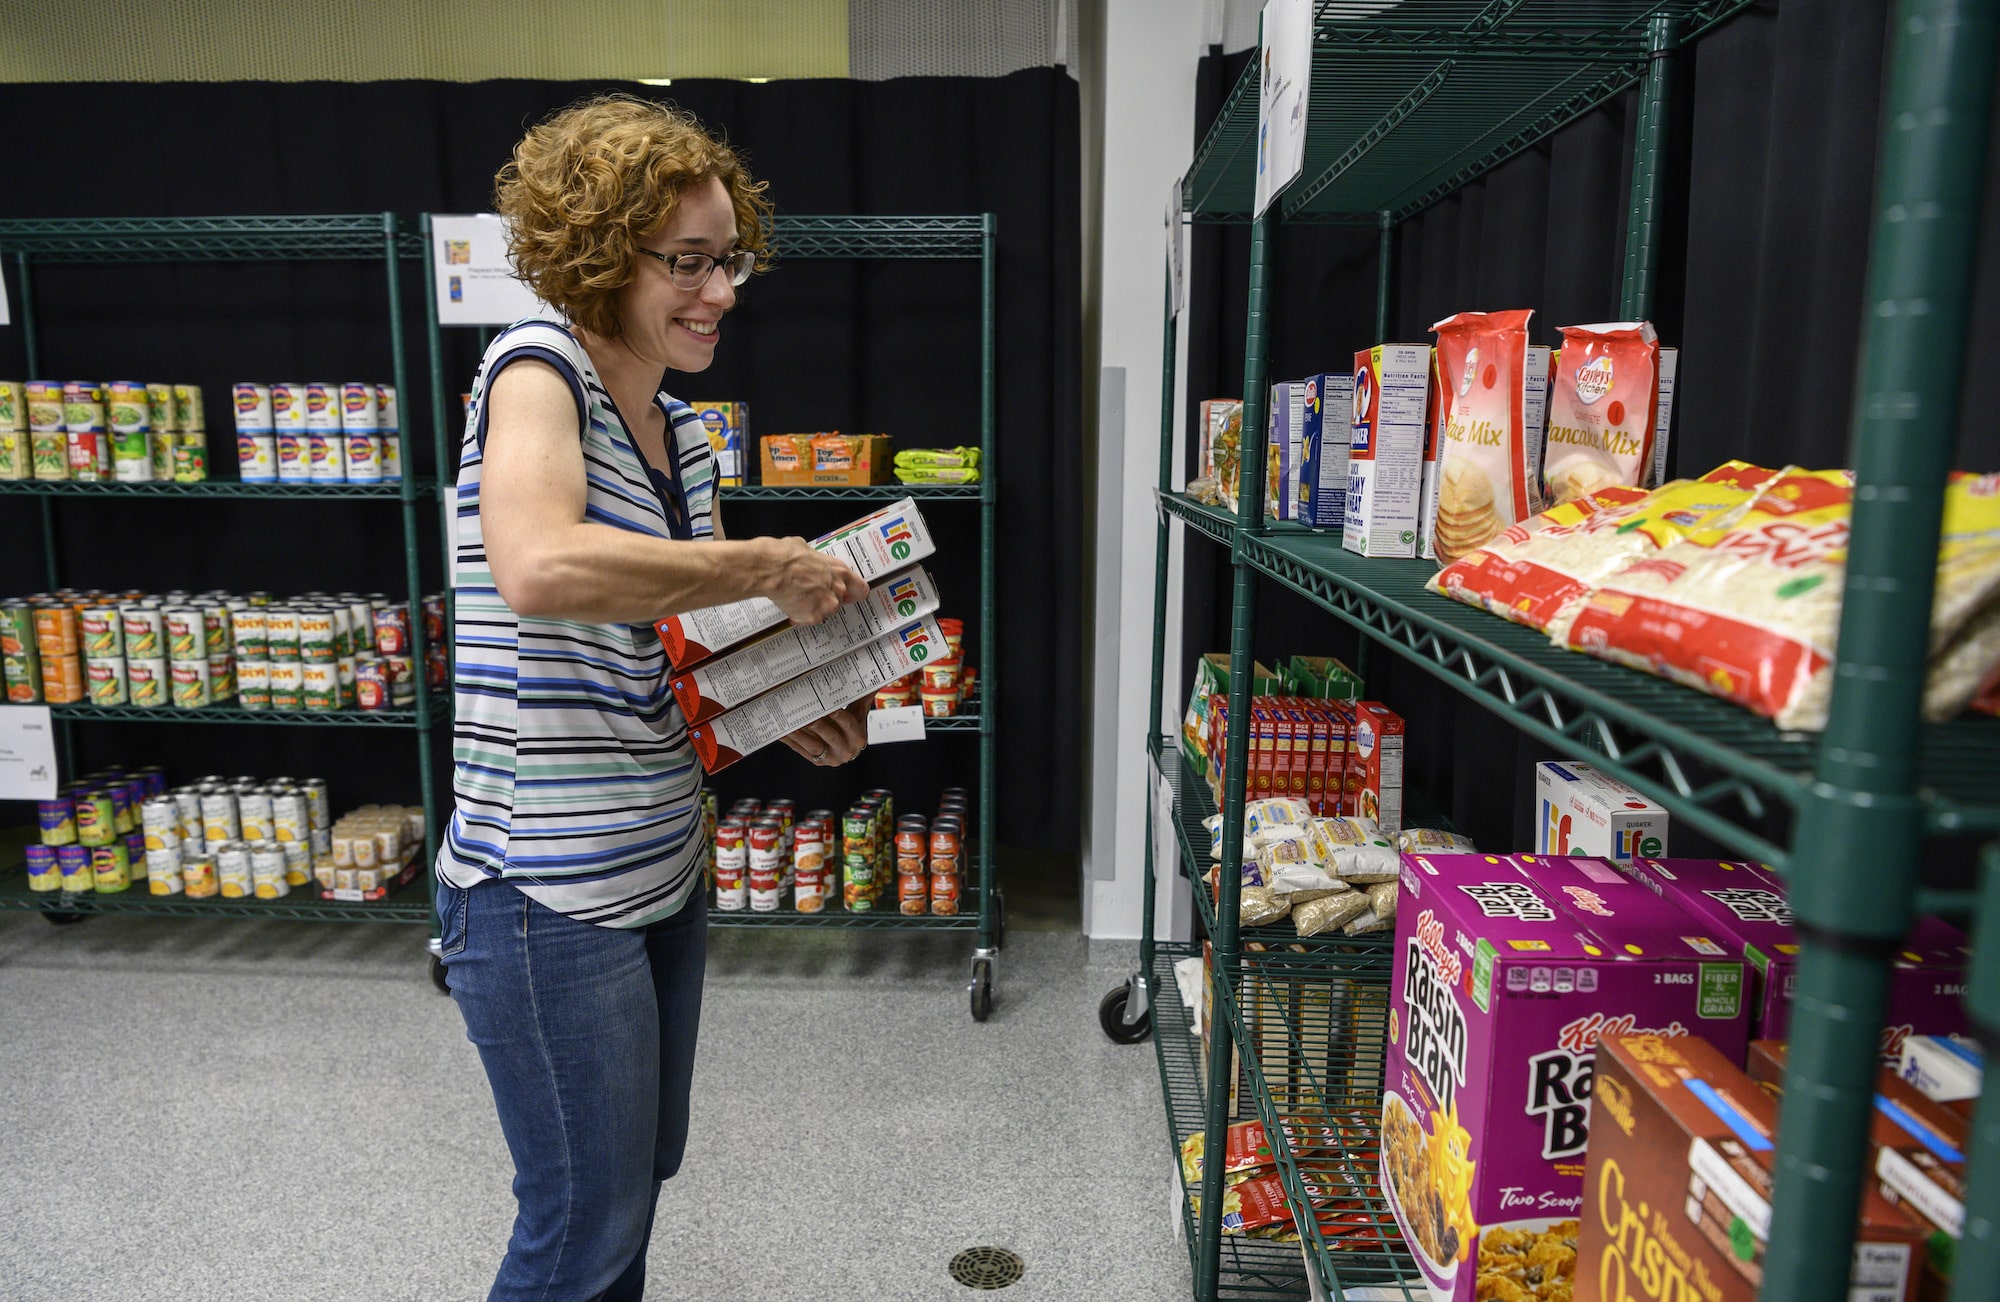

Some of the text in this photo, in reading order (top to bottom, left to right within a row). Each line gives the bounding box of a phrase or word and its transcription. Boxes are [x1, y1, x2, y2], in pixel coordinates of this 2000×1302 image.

[1467, 420, 1503, 447] Mix
[1600, 429, 1641, 457] Mix
[816, 448, 834, 458] Top
[817, 454, 850, 464] Ramen
[814, 474, 839, 483] CHICKEN
[880, 517, 913, 561] Life
[855, 536, 875, 575] Nutrition Facts
[888, 577, 919, 618] Life
[898, 621, 930, 663] Life
[876, 641, 895, 676] Nutrition Facts
[1541, 798, 1588, 856] Lif
[1625, 821, 1652, 829] QUAKER
[1615, 829, 1663, 860] Life
[1461, 886, 1519, 916] Bran
[1484, 882, 1555, 921] Raisin
[1418, 909, 1461, 986] Kellogg's
[1654, 973, 1694, 984] 2 BAGS
[1704, 973, 1738, 984] FIBER
[1934, 984, 1969, 996] 2 BAG
[1405, 940, 1466, 1087] Raisin
[1703, 996, 1736, 1005] WHOLE
[1703, 1004, 1736, 1014] GRAIN
[1560, 1014, 1689, 1052] Kell's
[1406, 1003, 1454, 1119] Bran
[1499, 1187, 1583, 1212] Two Scoop
[1599, 1157, 1702, 1302] Crisp
